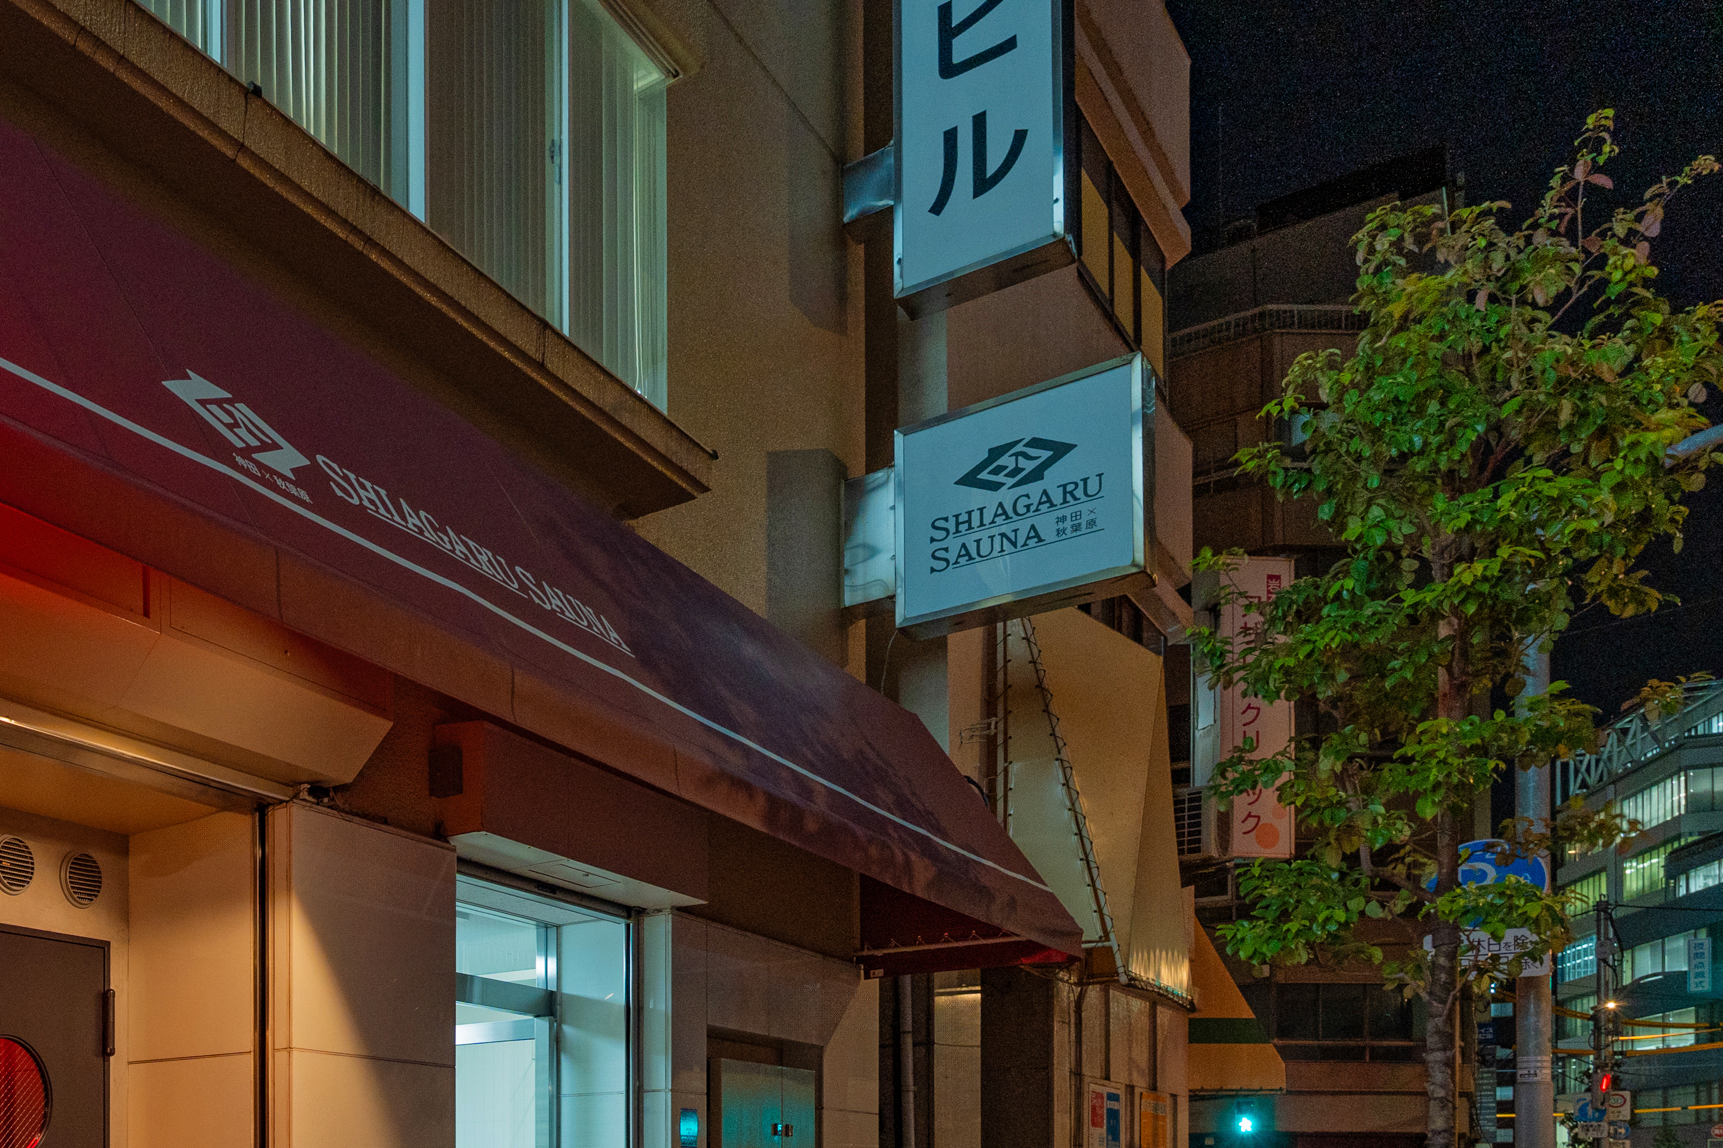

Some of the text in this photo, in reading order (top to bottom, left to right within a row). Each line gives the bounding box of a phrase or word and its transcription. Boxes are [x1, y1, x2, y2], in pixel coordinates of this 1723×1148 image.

[929, 472, 1105, 545] SHIAGARU
[1055, 517, 1098, 538] 秋葉原
[316, 455, 632, 651] SHIAGARU SAUNA
[929, 523, 1046, 575] SAUNA
